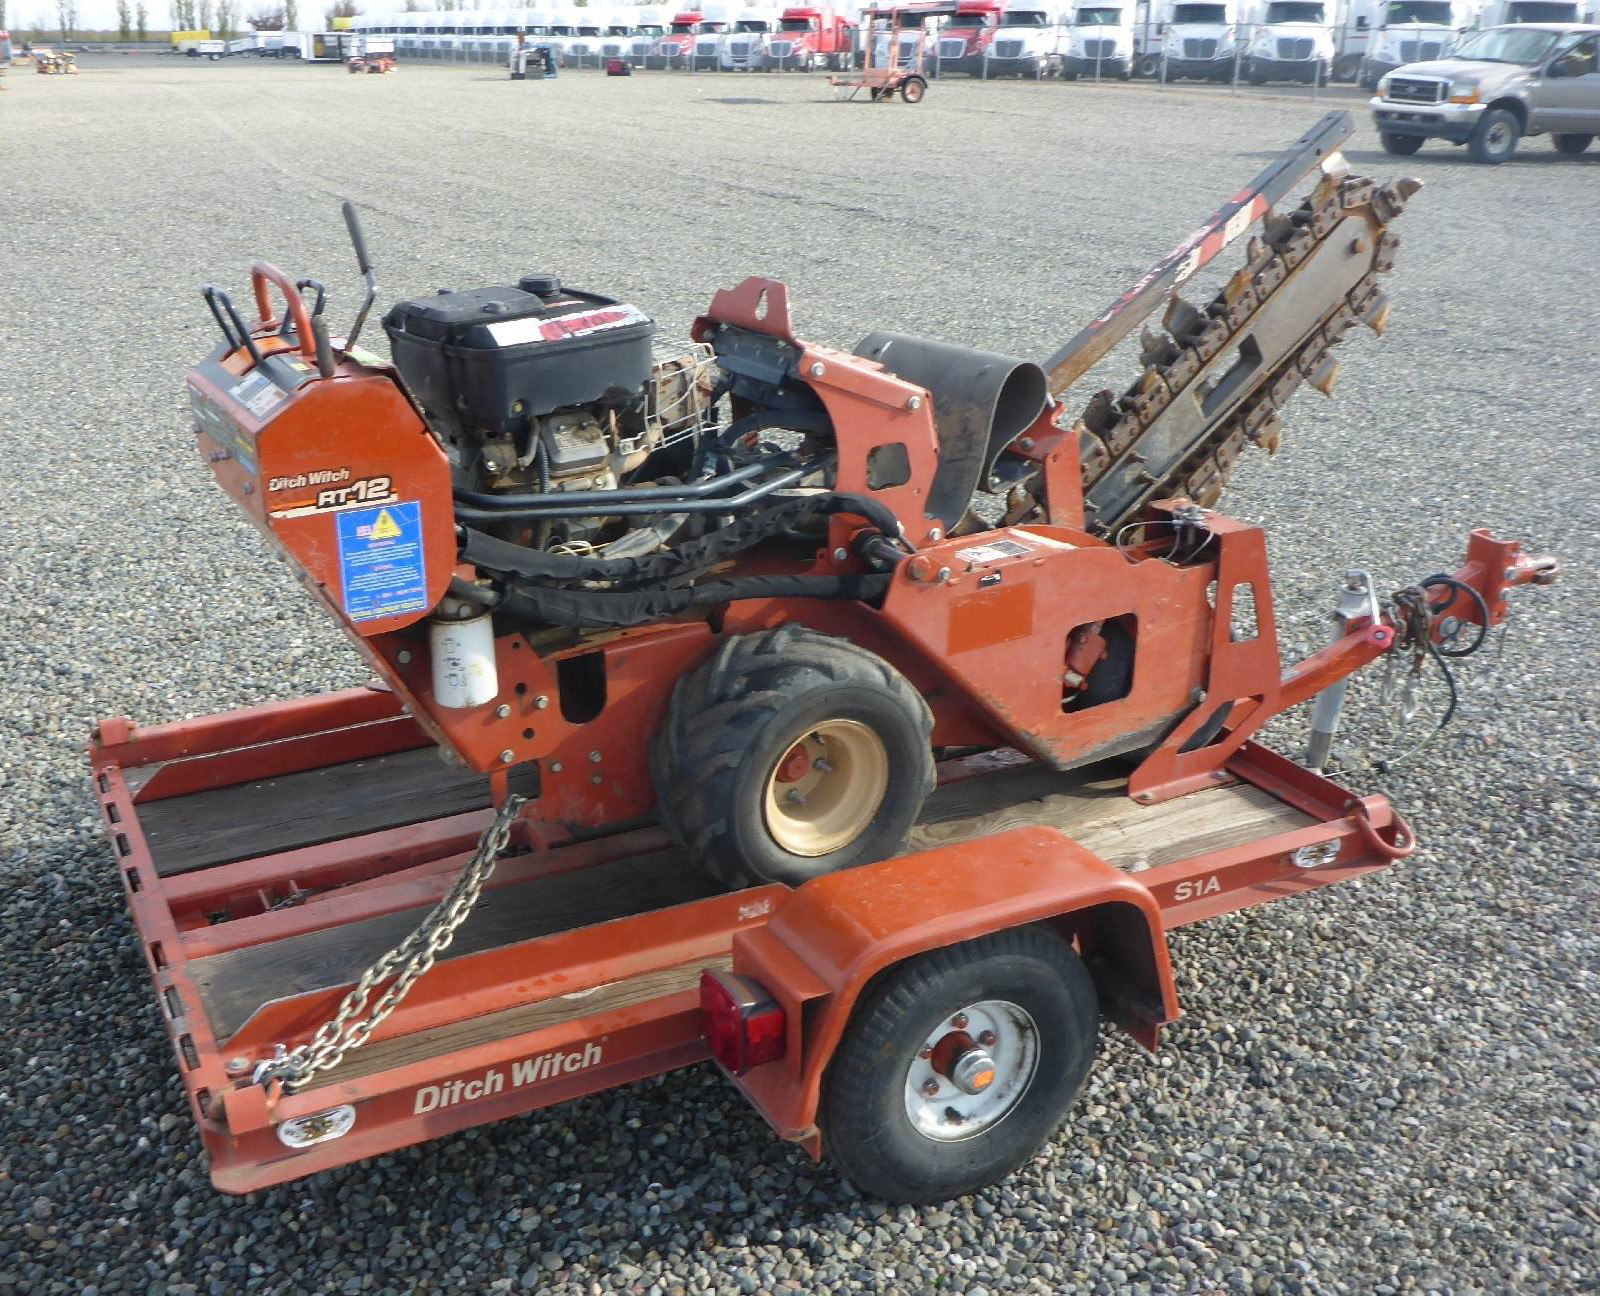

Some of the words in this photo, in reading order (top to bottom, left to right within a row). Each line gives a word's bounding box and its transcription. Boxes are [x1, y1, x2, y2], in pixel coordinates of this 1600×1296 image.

[269, 474, 307, 492] Ditch
[308, 467, 350, 485] Witch
[1173, 875, 1221, 901] S1A
[413, 1069, 505, 1115] Ditch
[511, 1042, 603, 1087] Witch
